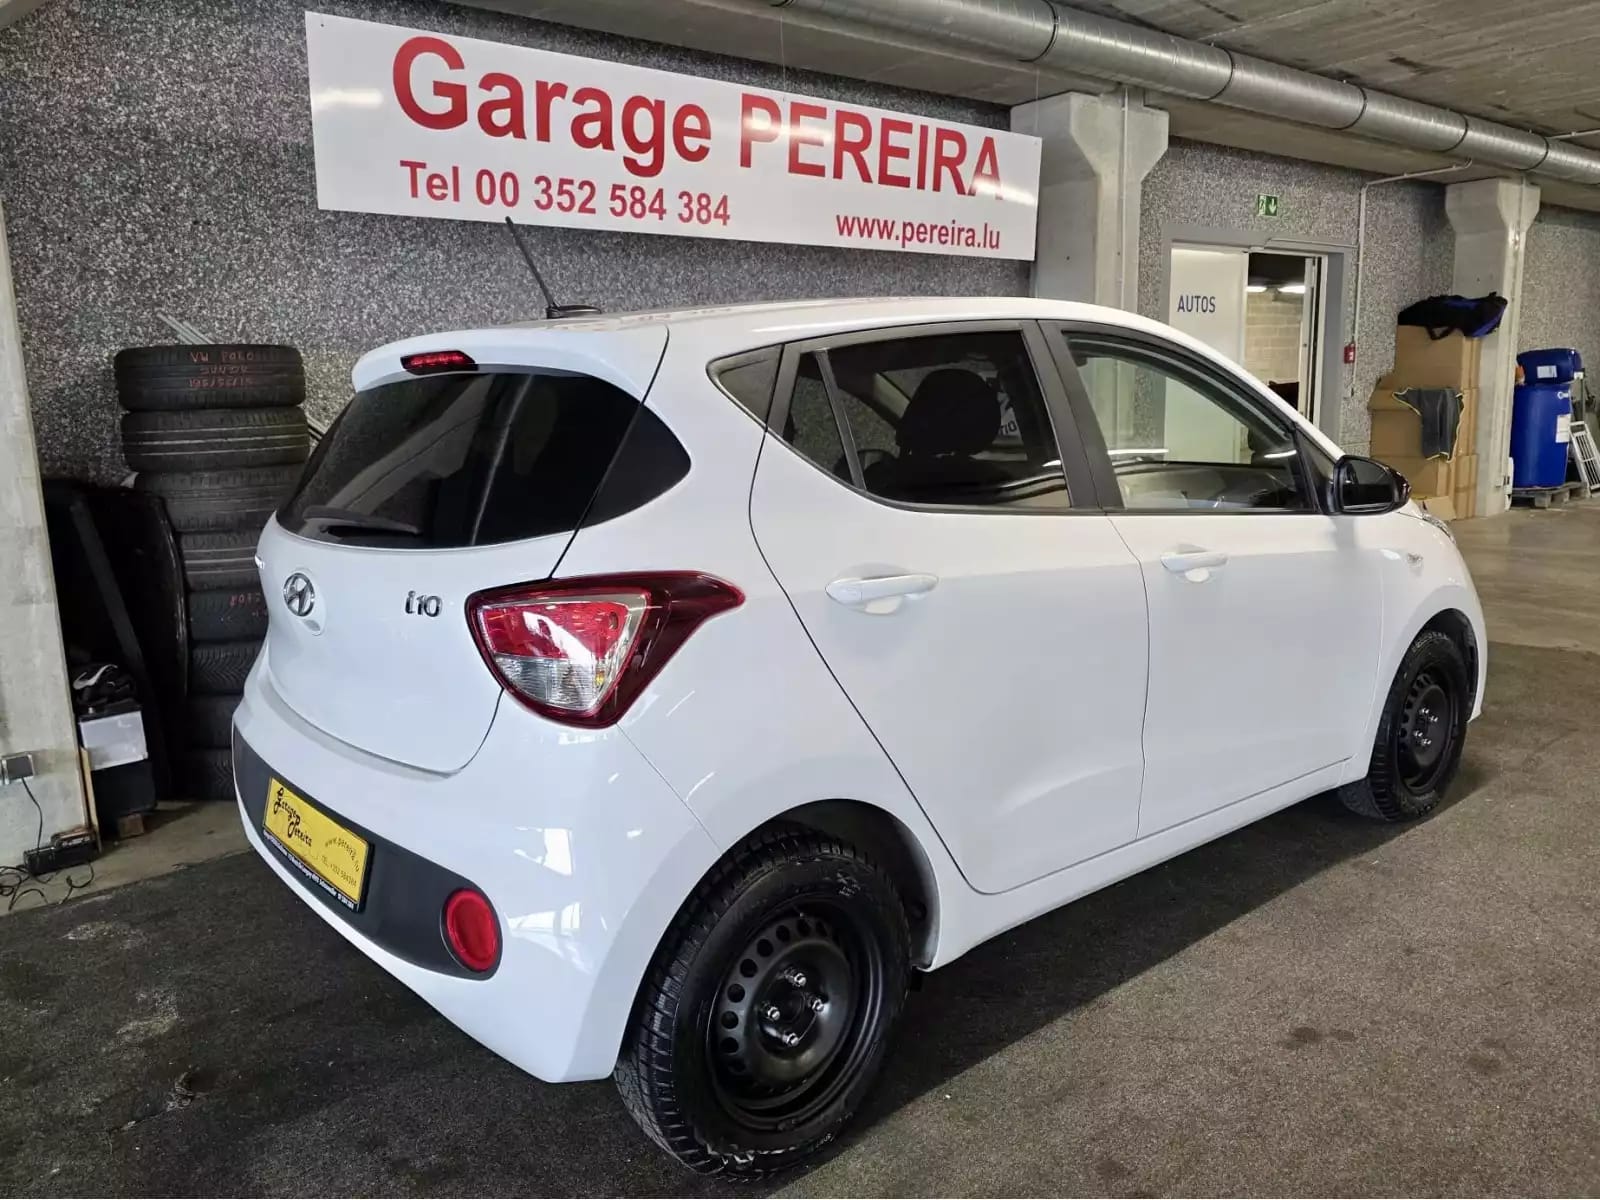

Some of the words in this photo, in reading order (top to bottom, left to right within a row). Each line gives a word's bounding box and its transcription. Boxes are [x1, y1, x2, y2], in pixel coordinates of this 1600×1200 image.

[392, 36, 712, 178] Garage
[739, 92, 1004, 201] PEREIRA
[399, 159, 460, 202] Tel
[475, 168, 520, 208] 00
[533, 174, 597, 215] 352
[609, 183, 667, 221] 584
[677, 190, 731, 226] 384
[836, 214, 1000, 250] www.pereira.lu
[1177, 295, 1216, 313] AUTOS
[404, 590, 443, 618] i10
